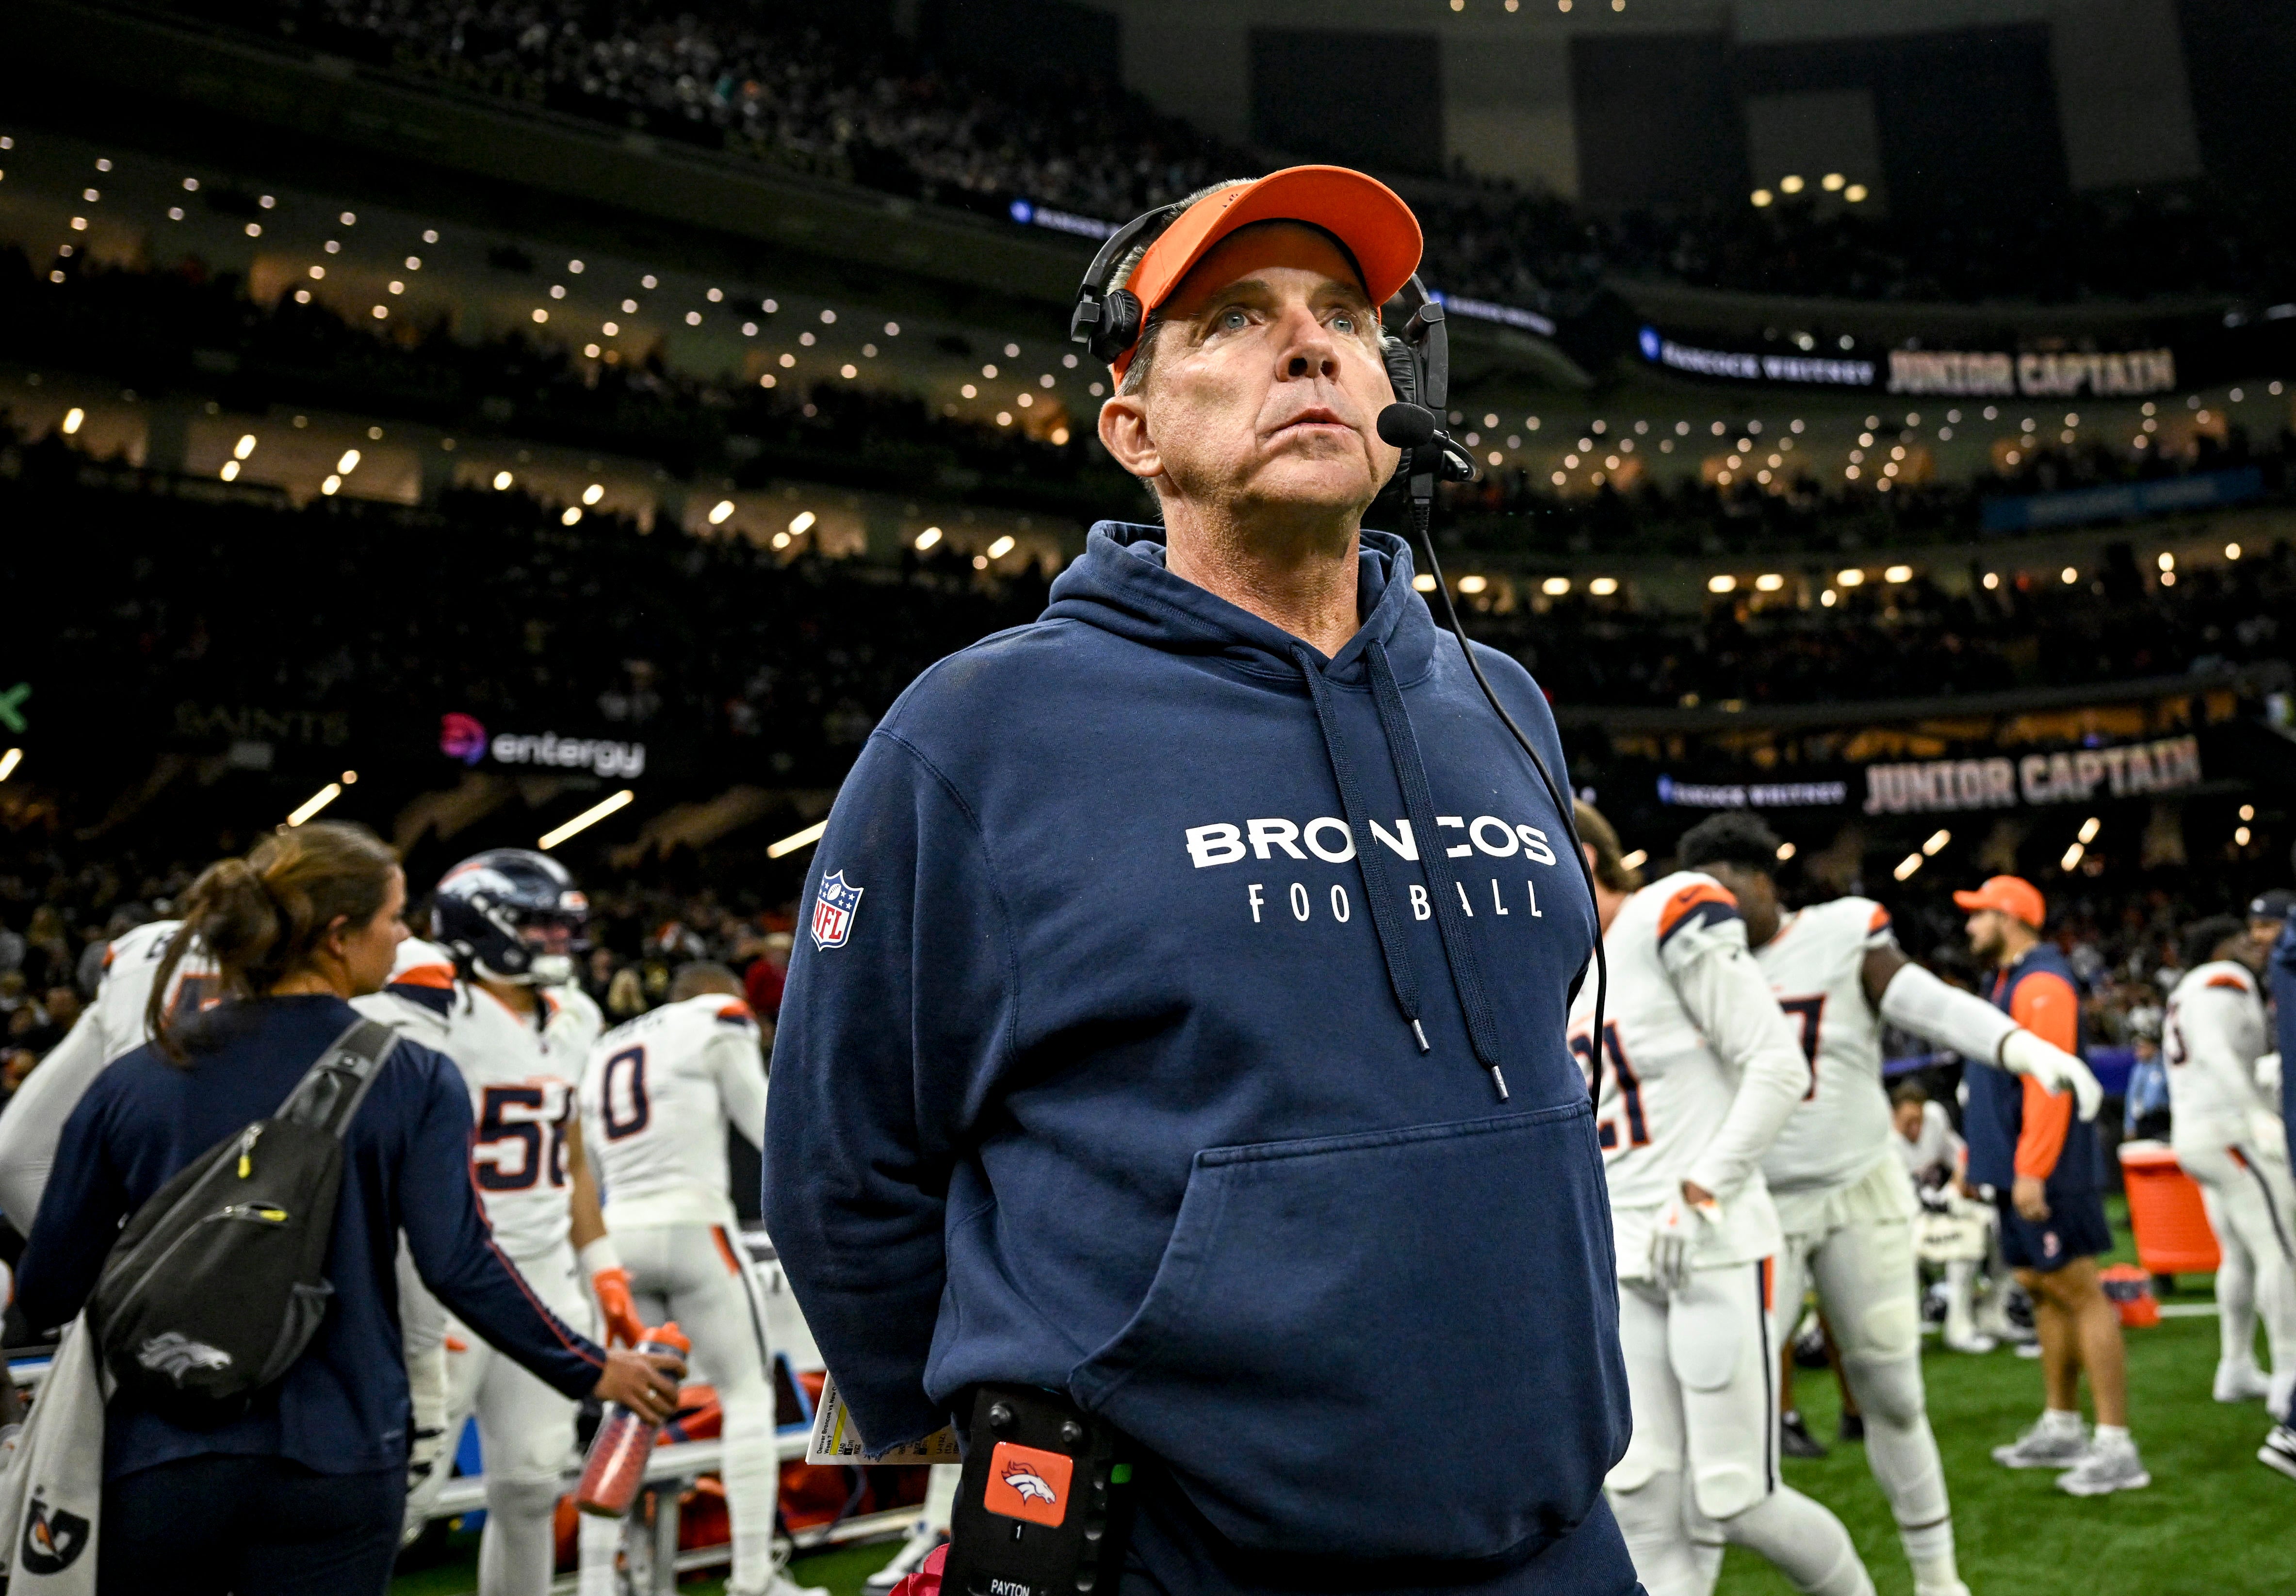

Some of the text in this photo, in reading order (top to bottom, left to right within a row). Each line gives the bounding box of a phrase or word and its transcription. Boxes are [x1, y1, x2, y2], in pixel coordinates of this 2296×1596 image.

[1889, 347, 2175, 395] JUNIOR CAPTAIN
[491, 730, 646, 779] entergy
[1863, 734, 2200, 815] JUNIOR CAPTAIN
[1186, 816, 1556, 868] BRONCOS
[813, 900, 842, 940] NFL
[1249, 879, 1542, 922] FOOBALL
[602, 1044, 649, 1142] 0
[817, 1435, 825, 1454] Denver
[822, 1412, 831, 1434] Broncos
[824, 1441, 832, 1454] Week
[1016, 1525, 1021, 1540] 1
[991, 1578, 1030, 1596] PAYTON
